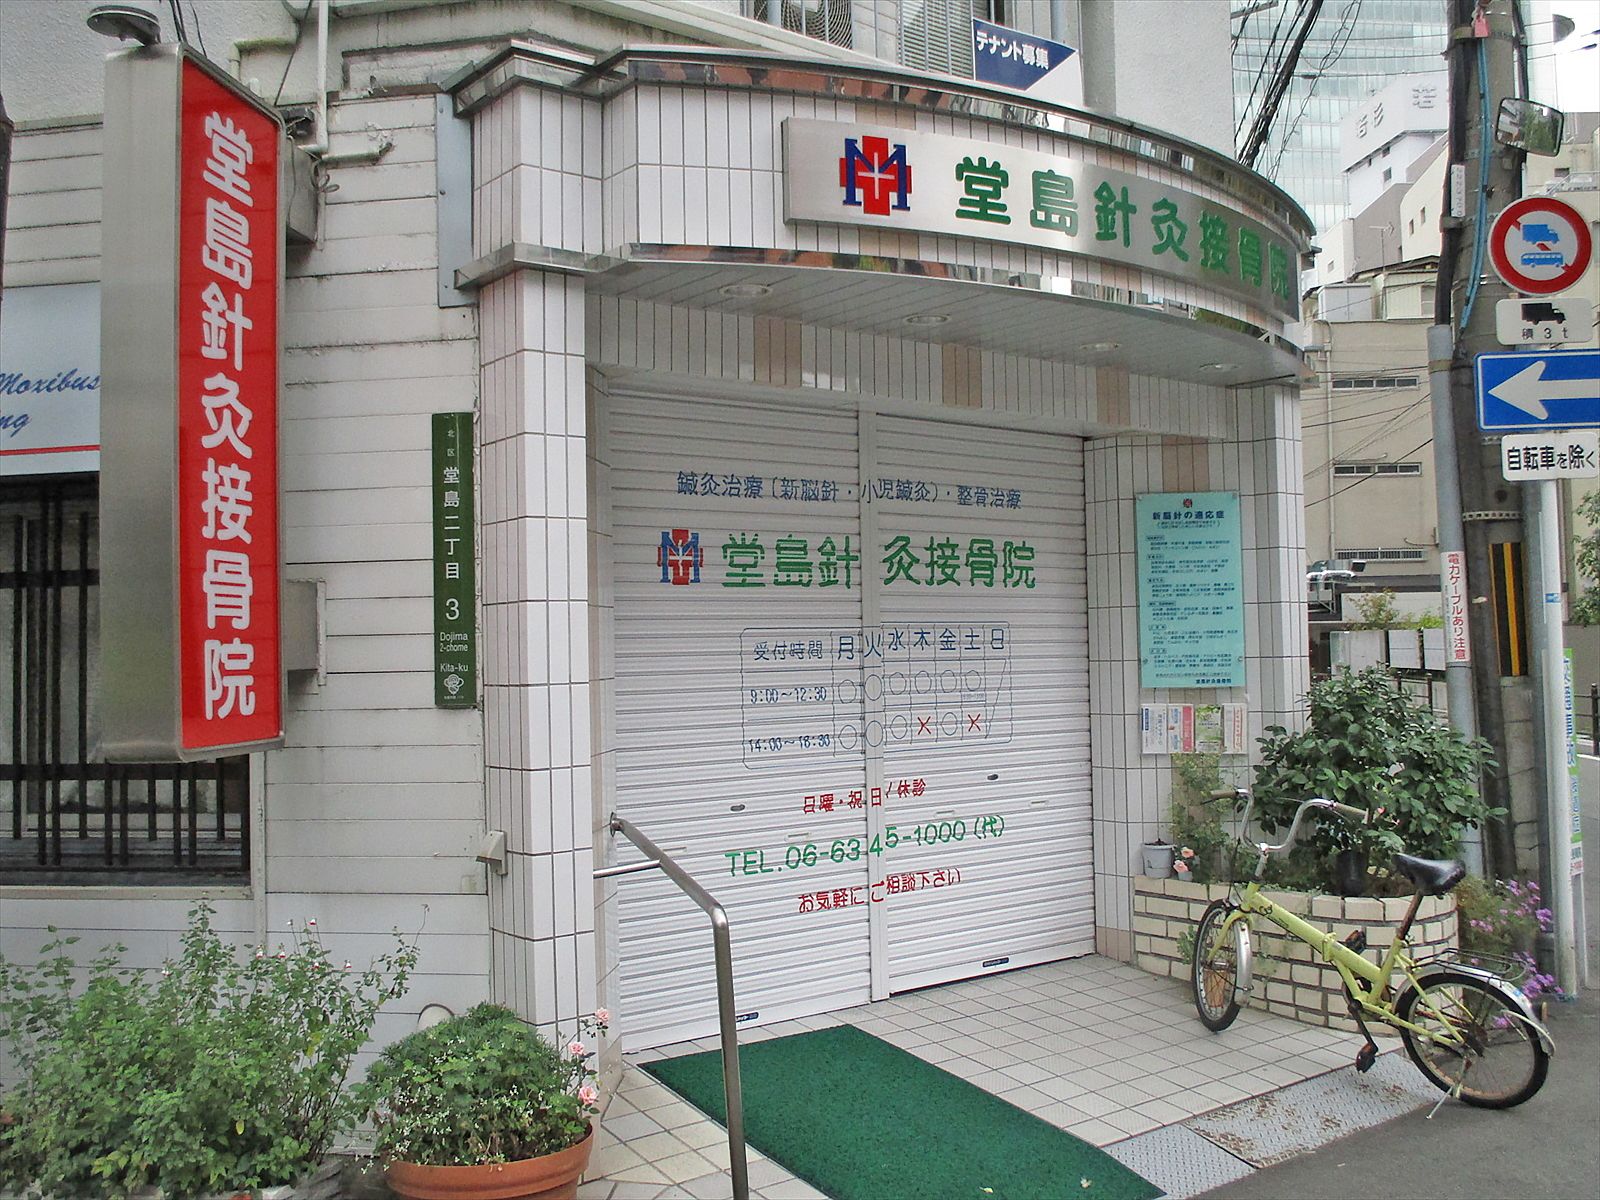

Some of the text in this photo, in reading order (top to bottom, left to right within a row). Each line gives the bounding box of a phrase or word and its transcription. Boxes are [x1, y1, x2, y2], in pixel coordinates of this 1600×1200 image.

[975, 30, 1049, 70] テナント募集
[955, 156, 1290, 301] 堂島針灸接骨院
[202, 110, 256, 721] 堂島針灸接骨院
[1507, 444, 1596, 471] 自転車を除く
[443, 466, 460, 579] 堂島二丁目
[445, 598, 460, 620] 3
[1448, 553, 1466, 660] 電力ケーブルあり注意
[440, 632, 468, 643] Dojima
[440, 643, 468, 652] 2-chome
[753, 627, 1005, 662] 受付時間 月 火 水 木 金 土 日
[440, 663, 468, 673] Kita-ku
[798, 868, 961, 913] お気軽にご相談下さい
